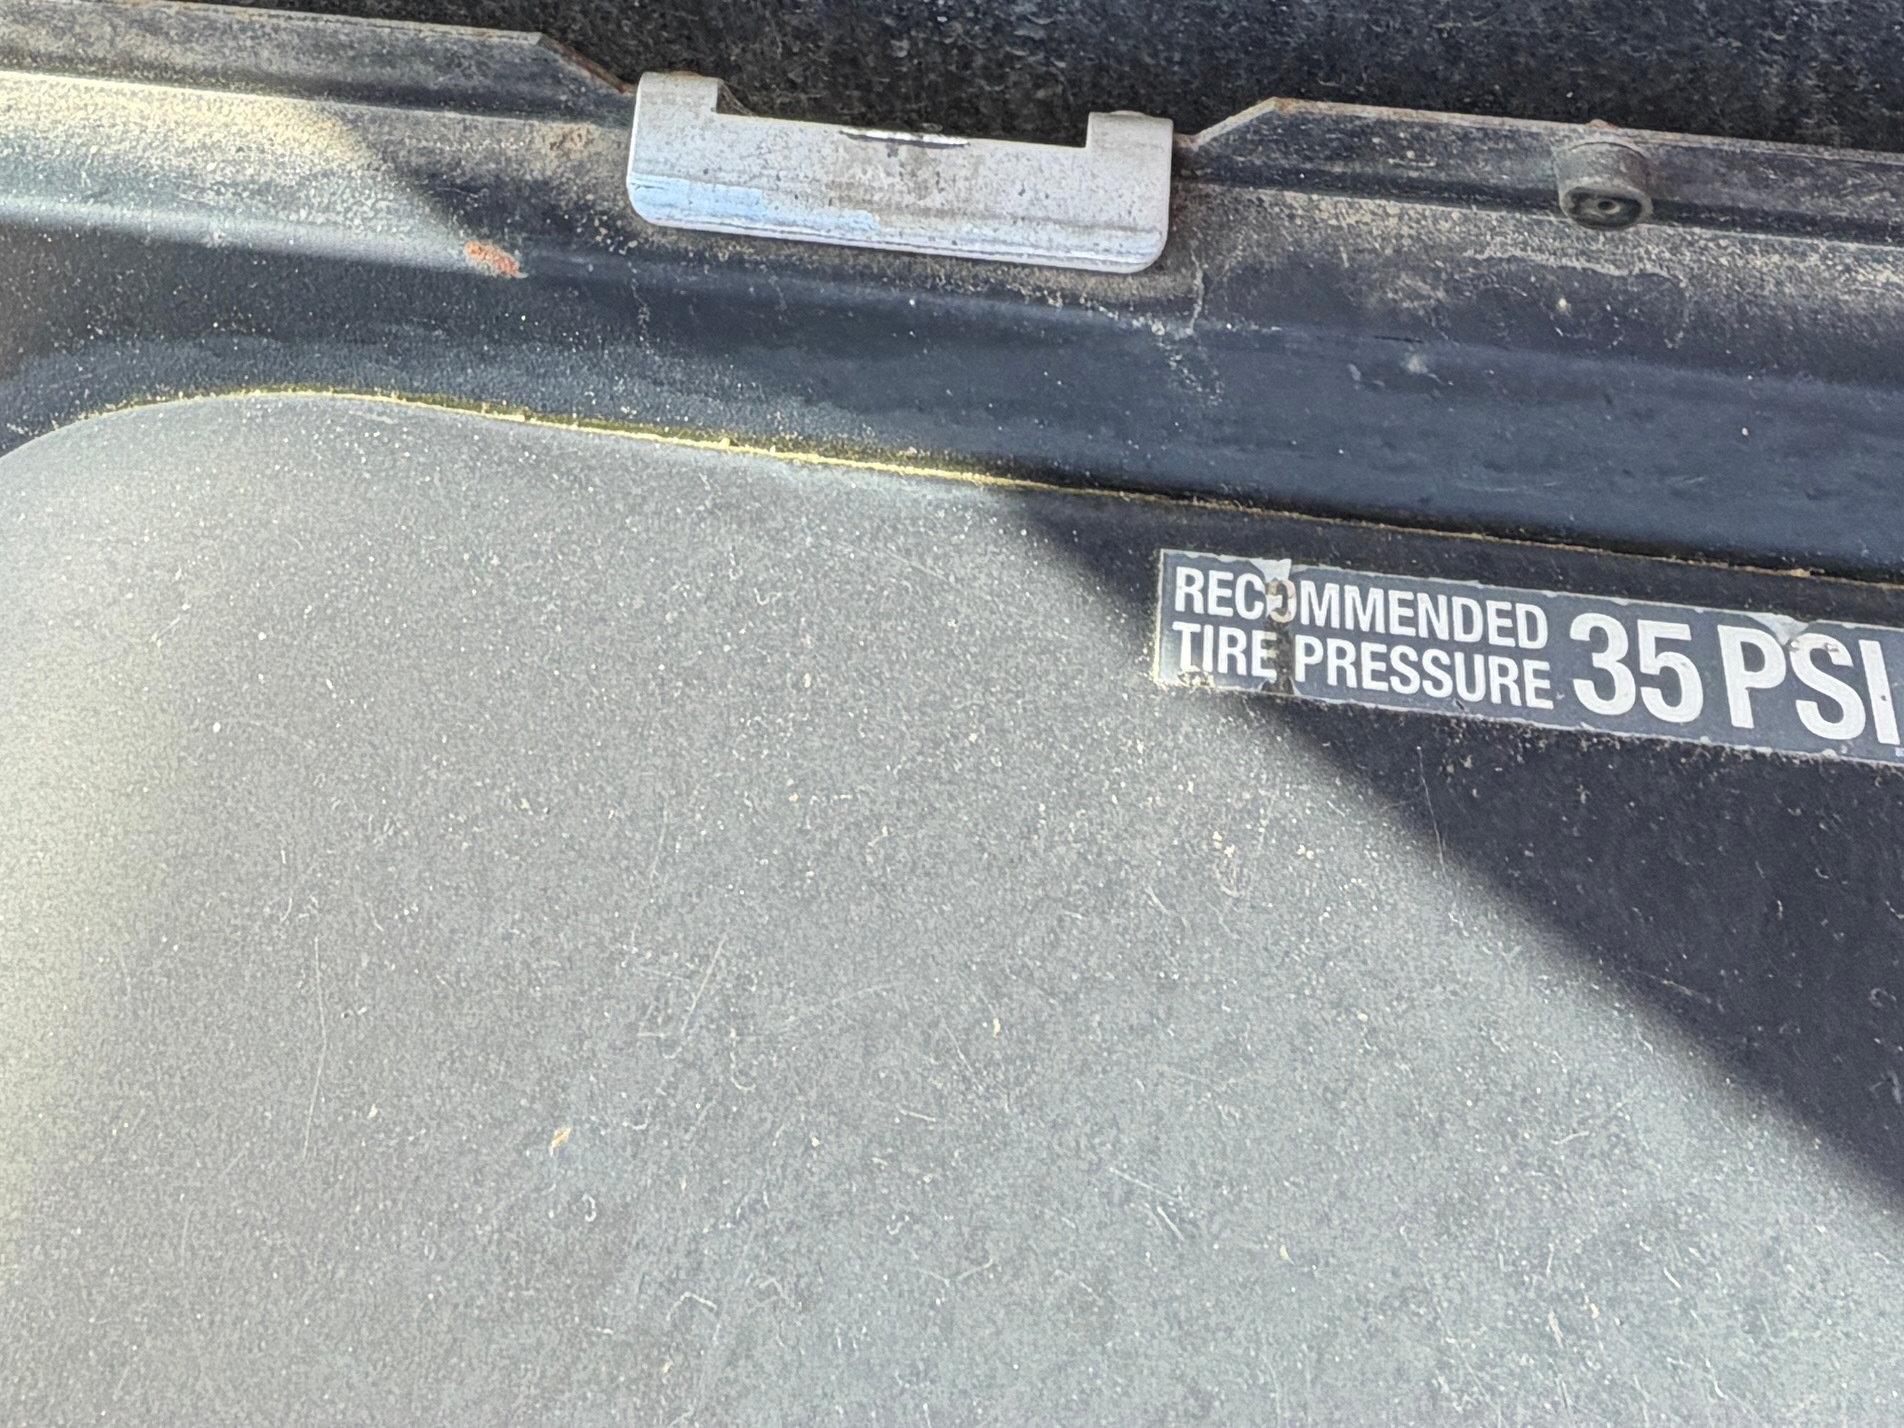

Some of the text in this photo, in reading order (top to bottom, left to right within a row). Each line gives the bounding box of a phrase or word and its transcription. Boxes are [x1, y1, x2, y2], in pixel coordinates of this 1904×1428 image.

[1172, 565, 1548, 651] RECOMMENDED
[1170, 620, 1554, 711] TIRE PRESSURE
[1570, 612, 1901, 746] 35 PSI
